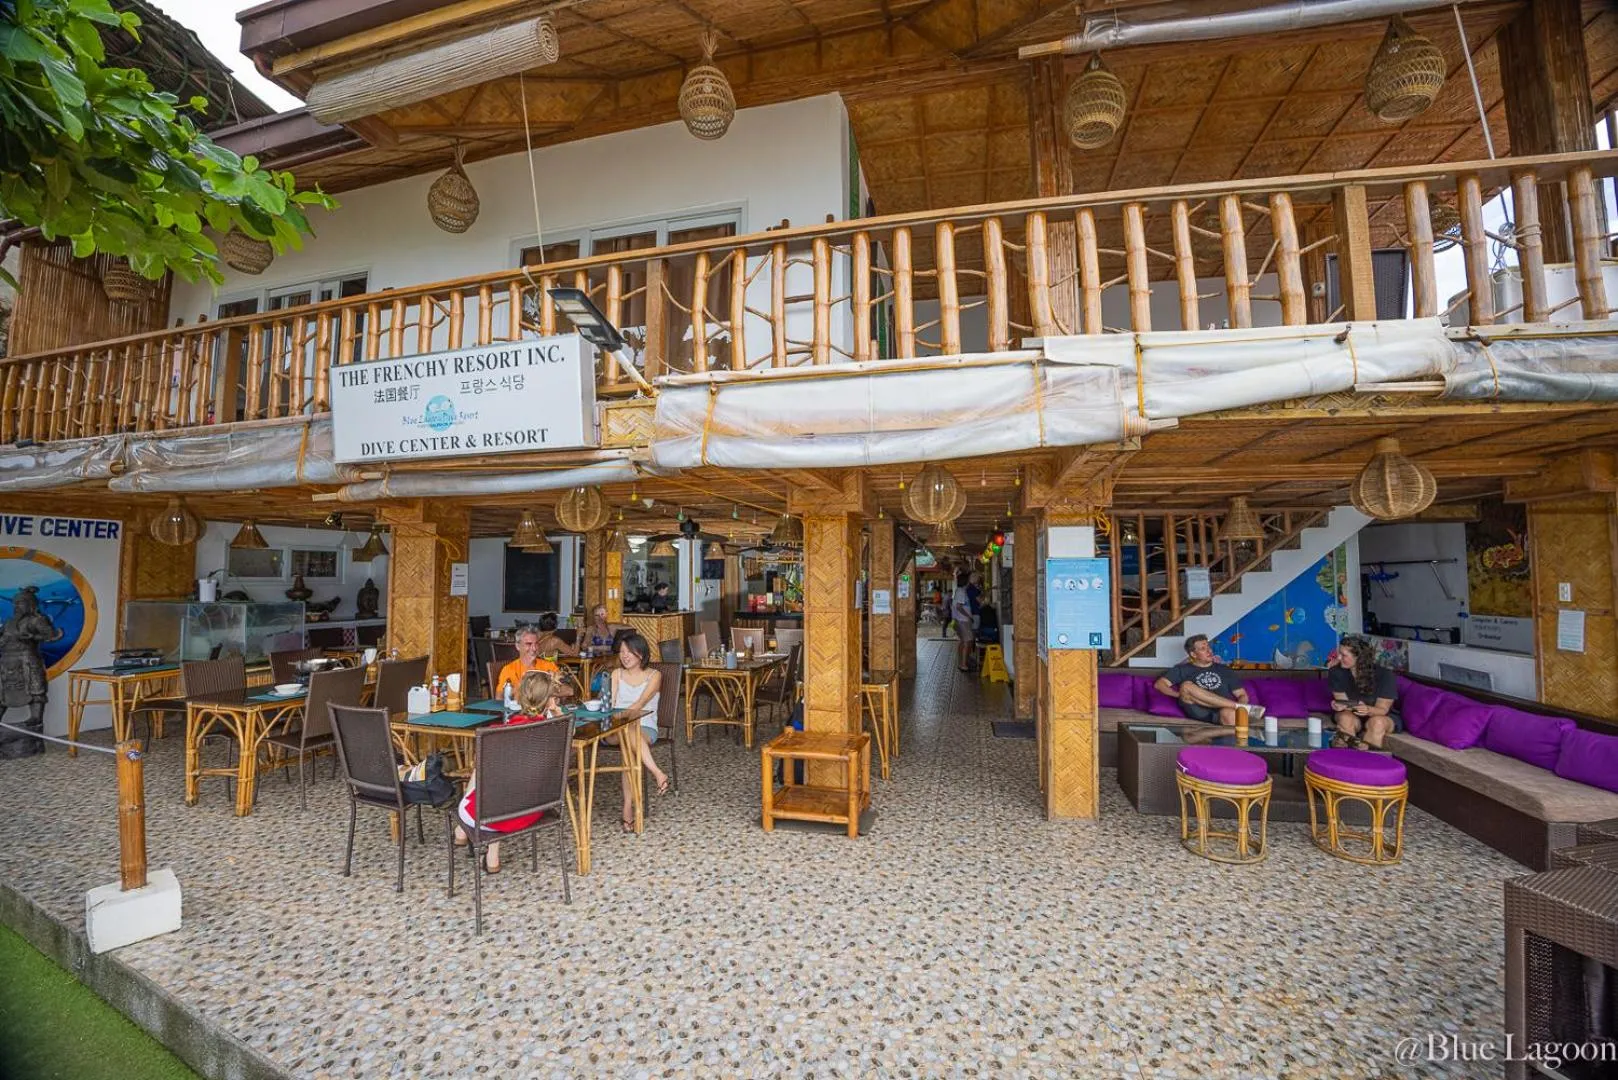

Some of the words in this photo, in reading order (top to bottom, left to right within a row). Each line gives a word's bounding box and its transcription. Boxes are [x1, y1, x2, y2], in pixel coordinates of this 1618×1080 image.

[339, 369, 369, 388] THE
[374, 358, 448, 384] FRENCHY
[454, 349, 522, 374] RESORT
[527, 344, 565, 365] INC.
[374, 384, 420, 403] 法国餐厅
[460, 378, 497, 394] 프랑스
[500, 374, 525, 391] 식당
[361, 440, 395, 456] DIVE
[400, 435, 460, 453] CENTER
[465, 434, 477, 448] &
[483, 428, 548, 447] RESORT
[40, 517, 119, 539] CENTER
